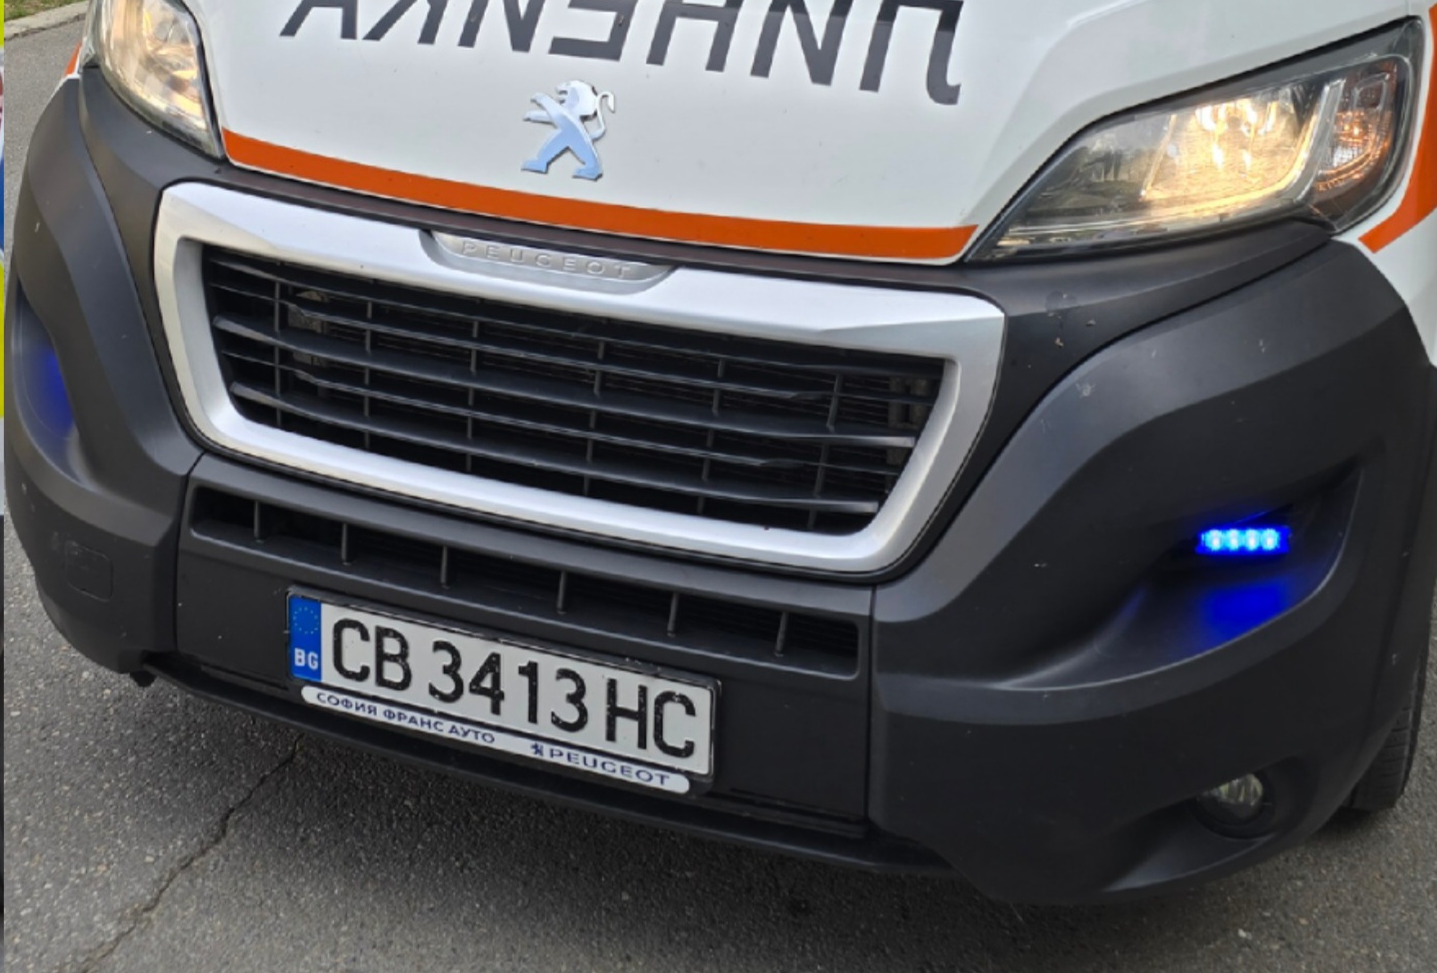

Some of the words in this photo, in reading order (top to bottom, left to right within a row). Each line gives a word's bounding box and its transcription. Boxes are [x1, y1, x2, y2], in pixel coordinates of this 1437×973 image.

[463, 241, 631, 278] PEUGEOT
[293, 647, 319, 671] BG
[316, 692, 378, 717] СОФИЯ
[383, 708, 445, 733] ФРАНС
[448, 724, 496, 744] АУТО
[549, 747, 671, 788] PEUGEOT
